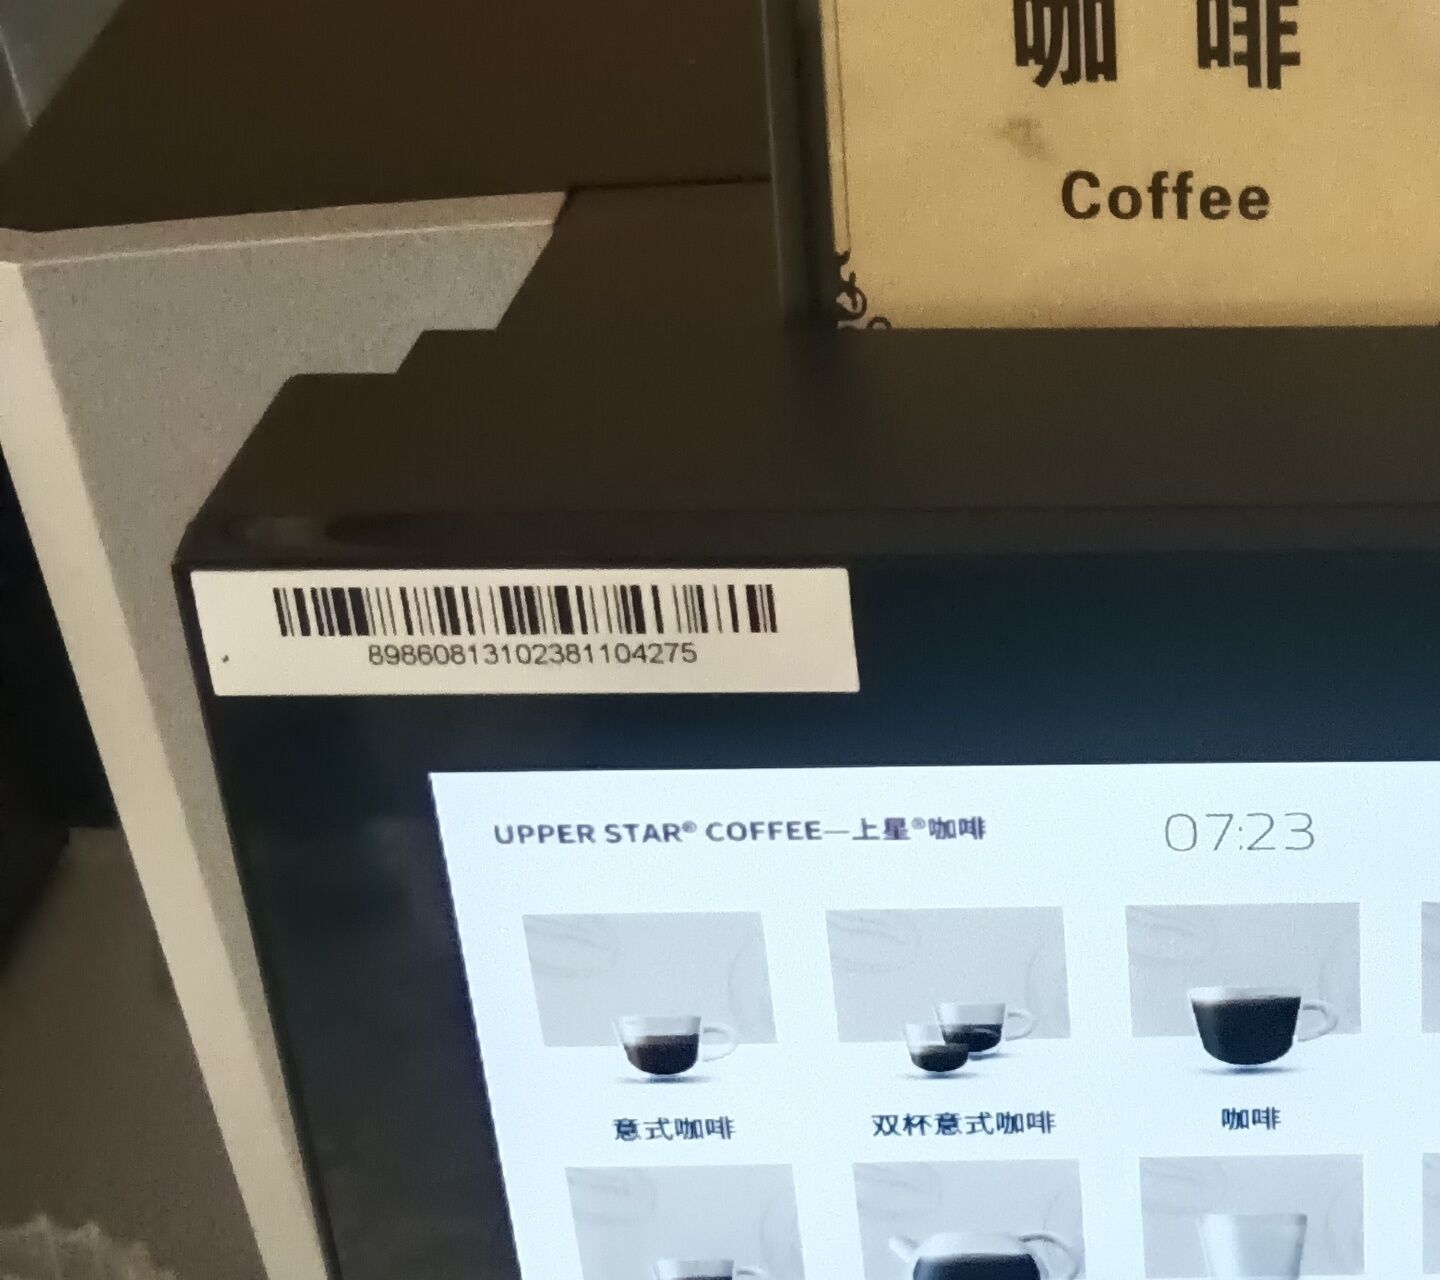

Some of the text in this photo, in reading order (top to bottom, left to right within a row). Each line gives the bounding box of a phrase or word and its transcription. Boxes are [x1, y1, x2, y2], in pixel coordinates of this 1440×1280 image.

[1060, 169, 1271, 222] Coffee
[367, 641, 698, 667] 89860813102381104275
[493, 823, 596, 845] UPPER
[1164, 811, 1316, 853] 07:23
[613, 1115, 734, 1142] 意式咖啡
[871, 1110, 1055, 1137] 双杯意式咖啡
[1221, 1106, 1281, 1131] 咖啡
